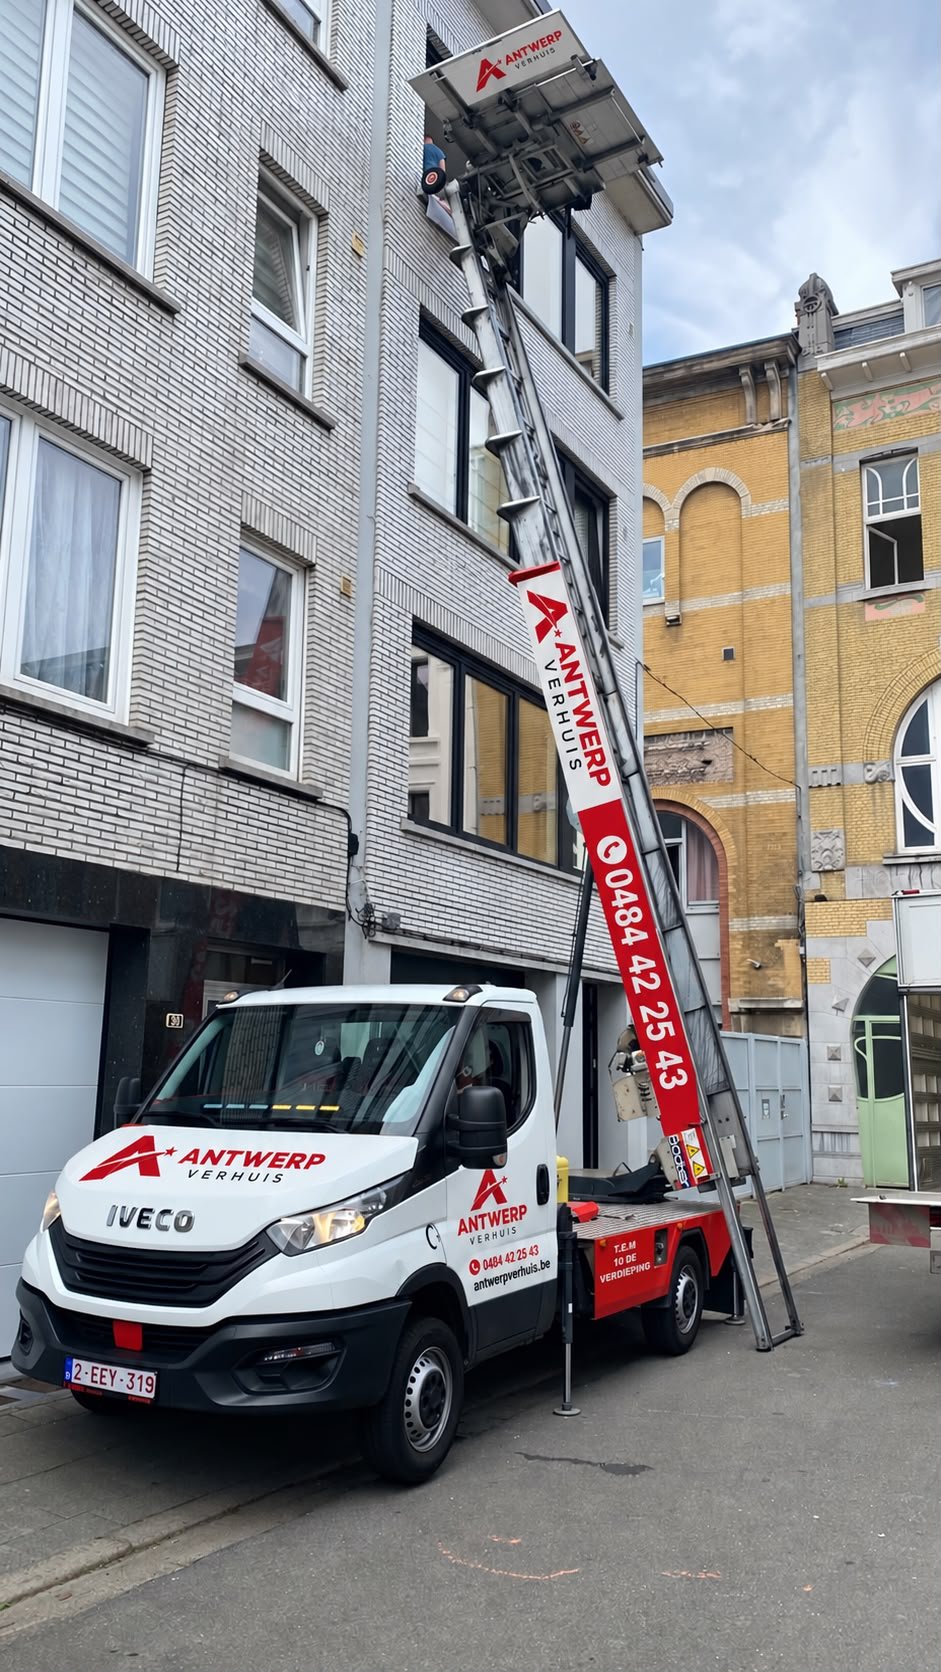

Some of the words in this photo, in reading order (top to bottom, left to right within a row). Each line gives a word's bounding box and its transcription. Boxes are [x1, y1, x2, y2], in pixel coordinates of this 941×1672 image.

[505, 30, 562, 66] ANTWERP
[514, 47, 556, 70] VERHUIS
[544, 659, 582, 771] VERHUIS
[555, 642, 611, 787] ANTWERP
[604, 868, 649, 946] 0484
[628, 954, 661, 995] 42
[639, 1001, 676, 1042] 25
[655, 1050, 689, 1090] 43
[177, 1147, 327, 1170] ANTWERP
[187, 1168, 284, 1184] VERHUIS
[106, 1204, 196, 1233] IVECO
[457, 1204, 528, 1237] ANTWERP
[469, 1226, 517, 1245] VERHUIS
[482, 1255, 503, 1271] 0484
[505, 1251, 515, 1264] 42
[516, 1247, 527, 1261] 25
[528, 1244, 539, 1257] 43
[599, 1261, 651, 1284] VERDIEPING
[613, 1257, 624, 1267] 10
[625, 1253, 637, 1264] DE
[473, 1259, 551, 1292] antwerpverhuis.be
[73, 1363, 155, 1394] 2-EEY-319
